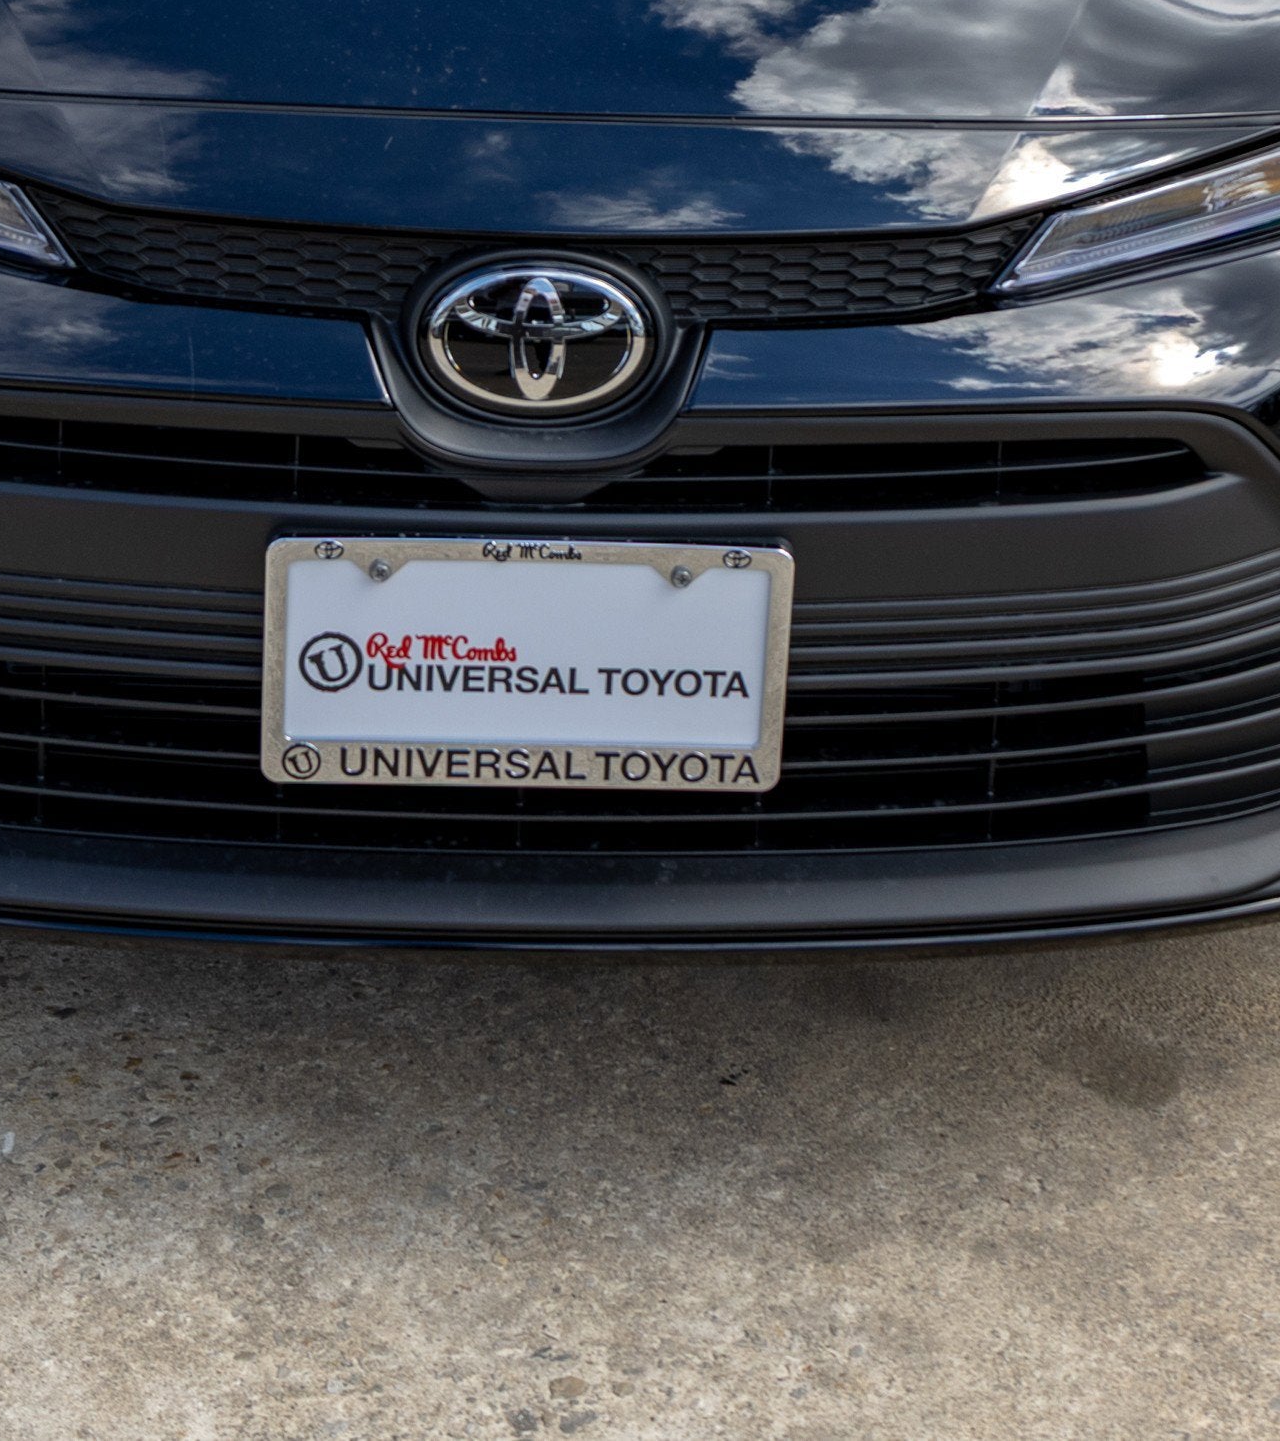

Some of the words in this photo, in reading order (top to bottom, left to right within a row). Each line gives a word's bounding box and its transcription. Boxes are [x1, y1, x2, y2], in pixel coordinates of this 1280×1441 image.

[482, 540, 514, 562] Red
[515, 541, 583, 561] McCombs
[366, 631, 412, 670] Red
[415, 633, 518, 663] McCombs
[366, 662, 591, 696] UNIVERSAL
[598, 668, 751, 699] TOYOTA
[339, 743, 588, 782] UNIVERSAL
[595, 748, 761, 784] TOYOTA
